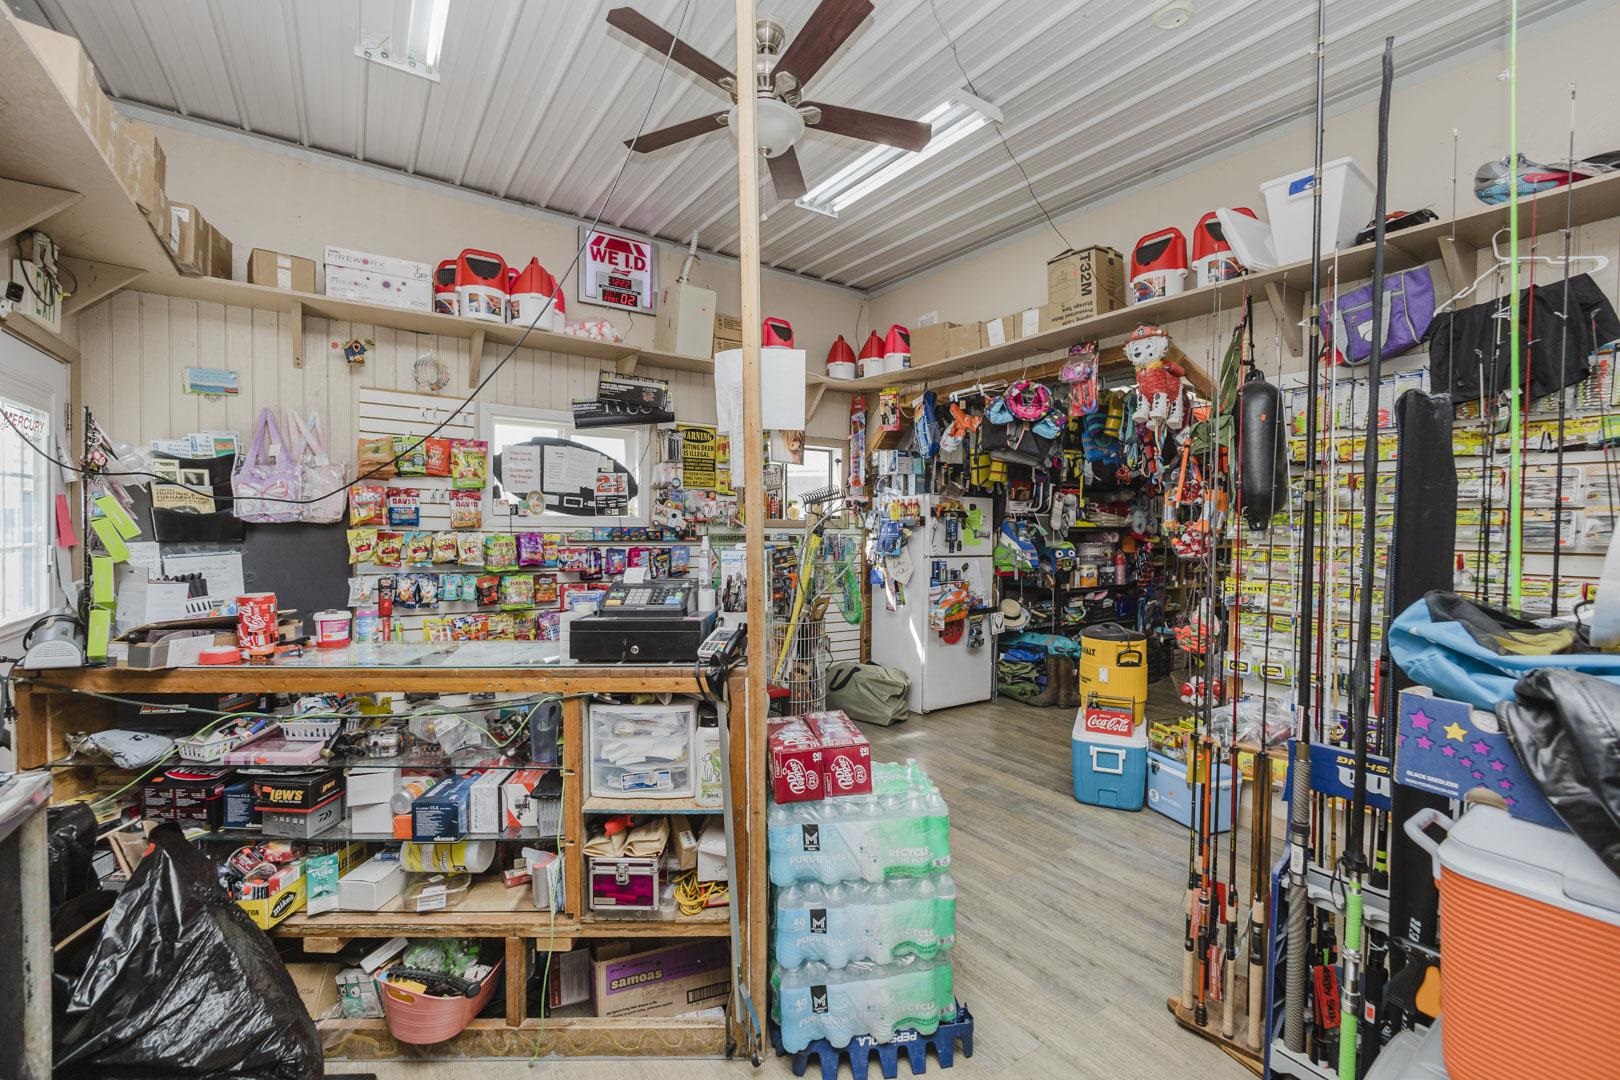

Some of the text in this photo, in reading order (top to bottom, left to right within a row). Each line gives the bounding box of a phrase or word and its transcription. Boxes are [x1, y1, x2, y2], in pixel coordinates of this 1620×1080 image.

[590, 246, 648, 272] WE I.D.
[1080, 252, 1092, 296] T32M
[4, 411, 44, 433] MERCURY
[1087, 715, 1130, 732] Coca-Cola
[786, 770, 796, 782] Dr
[790, 762, 806, 794] Pepper
[834, 766, 844, 778] Dr
[838, 758, 854, 789] Pepper
[610, 970, 662, 989] samoas
[858, 1032, 918, 1046] PEPSOLA
